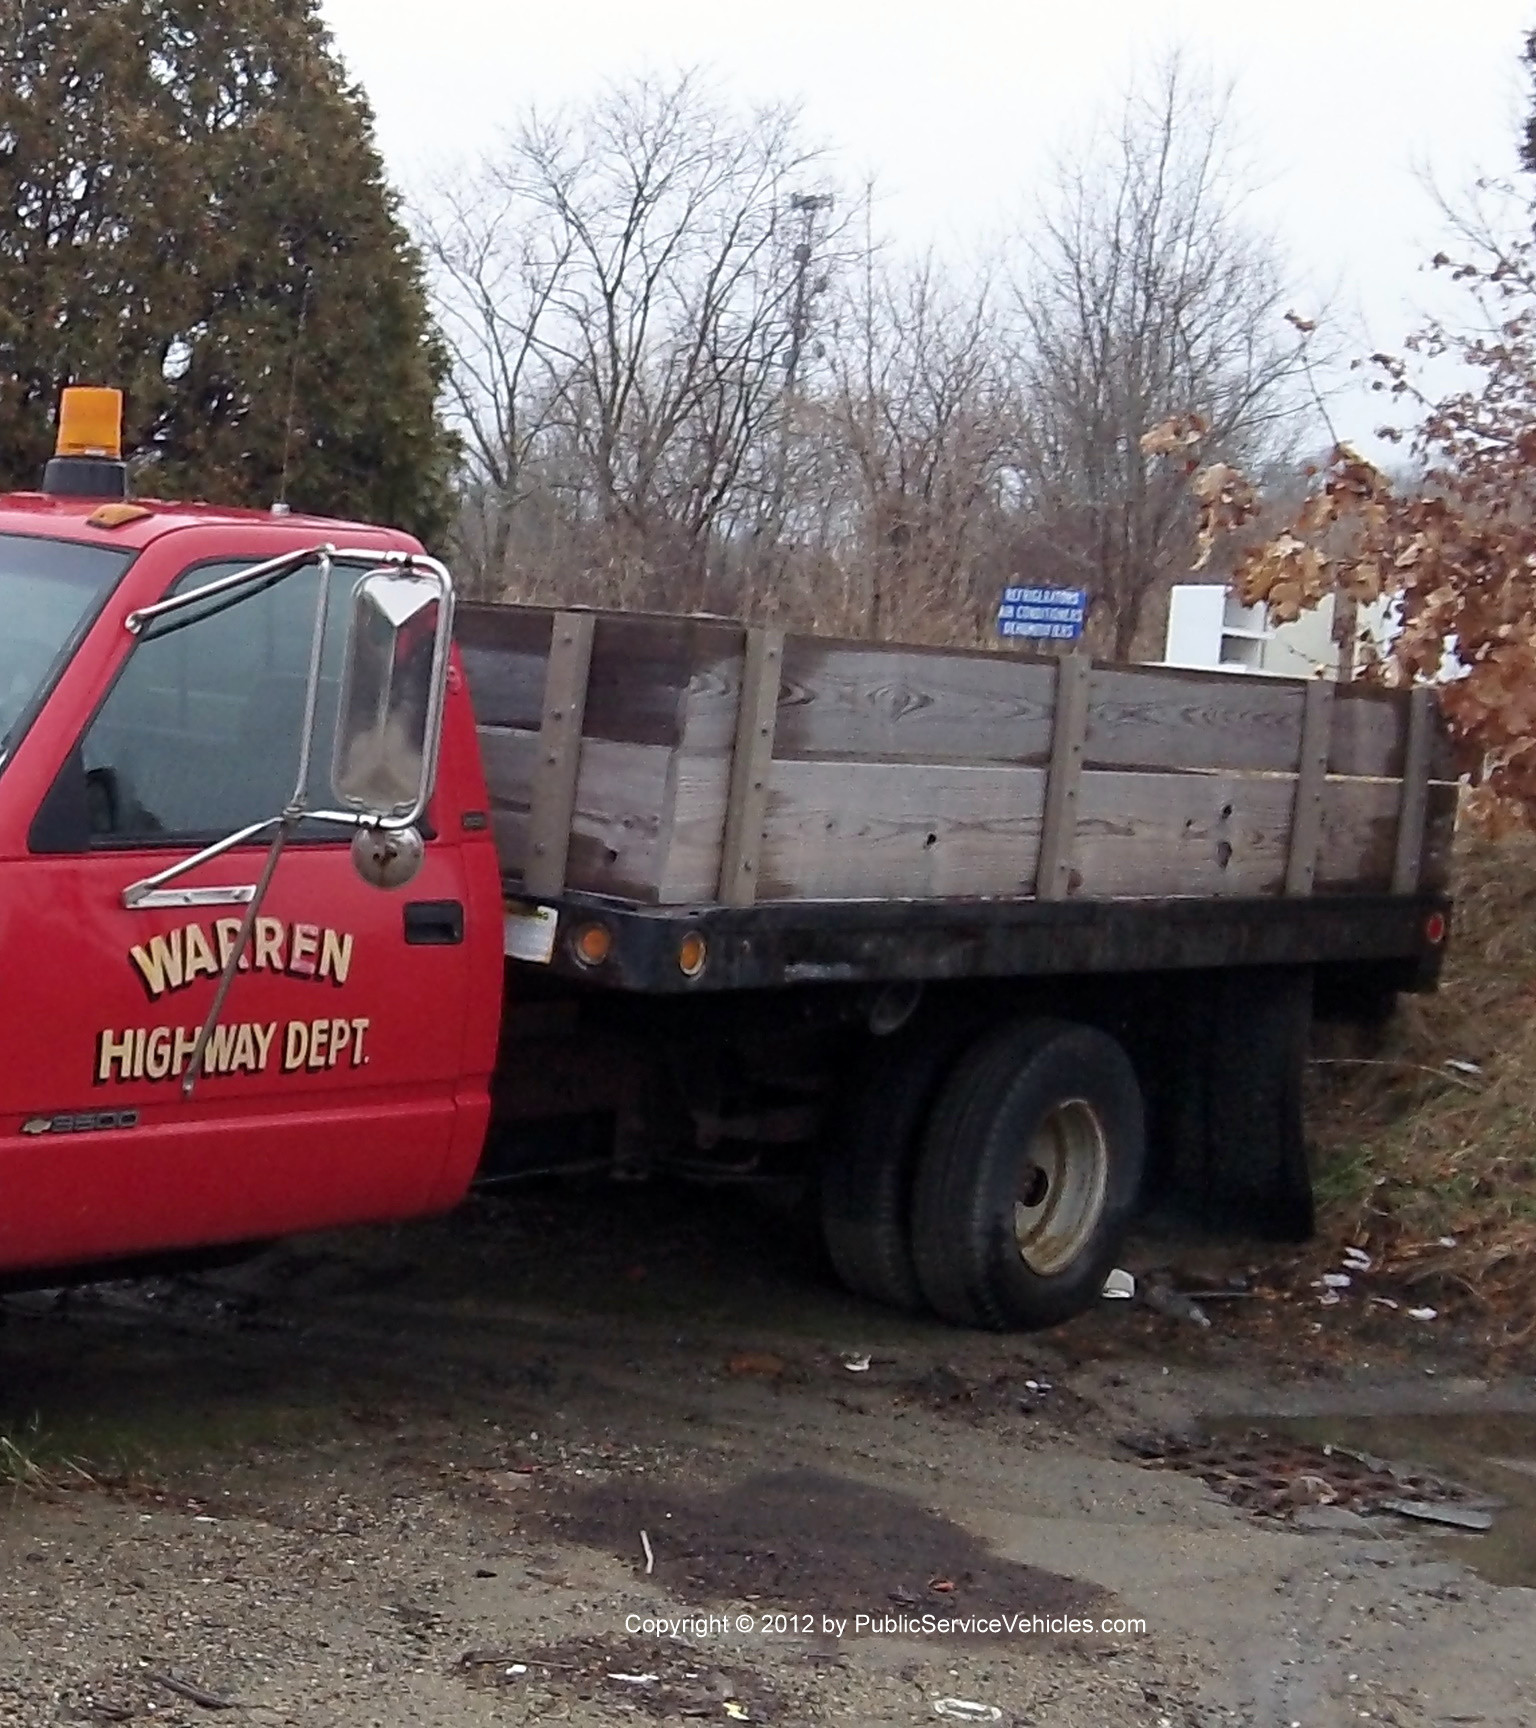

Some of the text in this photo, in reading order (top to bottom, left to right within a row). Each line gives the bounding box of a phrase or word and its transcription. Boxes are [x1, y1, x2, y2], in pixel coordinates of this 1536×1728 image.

[998, 605, 1083, 623] AIR CONDITIONERS
[1004, 588, 1079, 605] REFRIGERATORS
[128, 917, 354, 998] WARREN
[95, 1018, 371, 1082] HIGHWAY DEPT.
